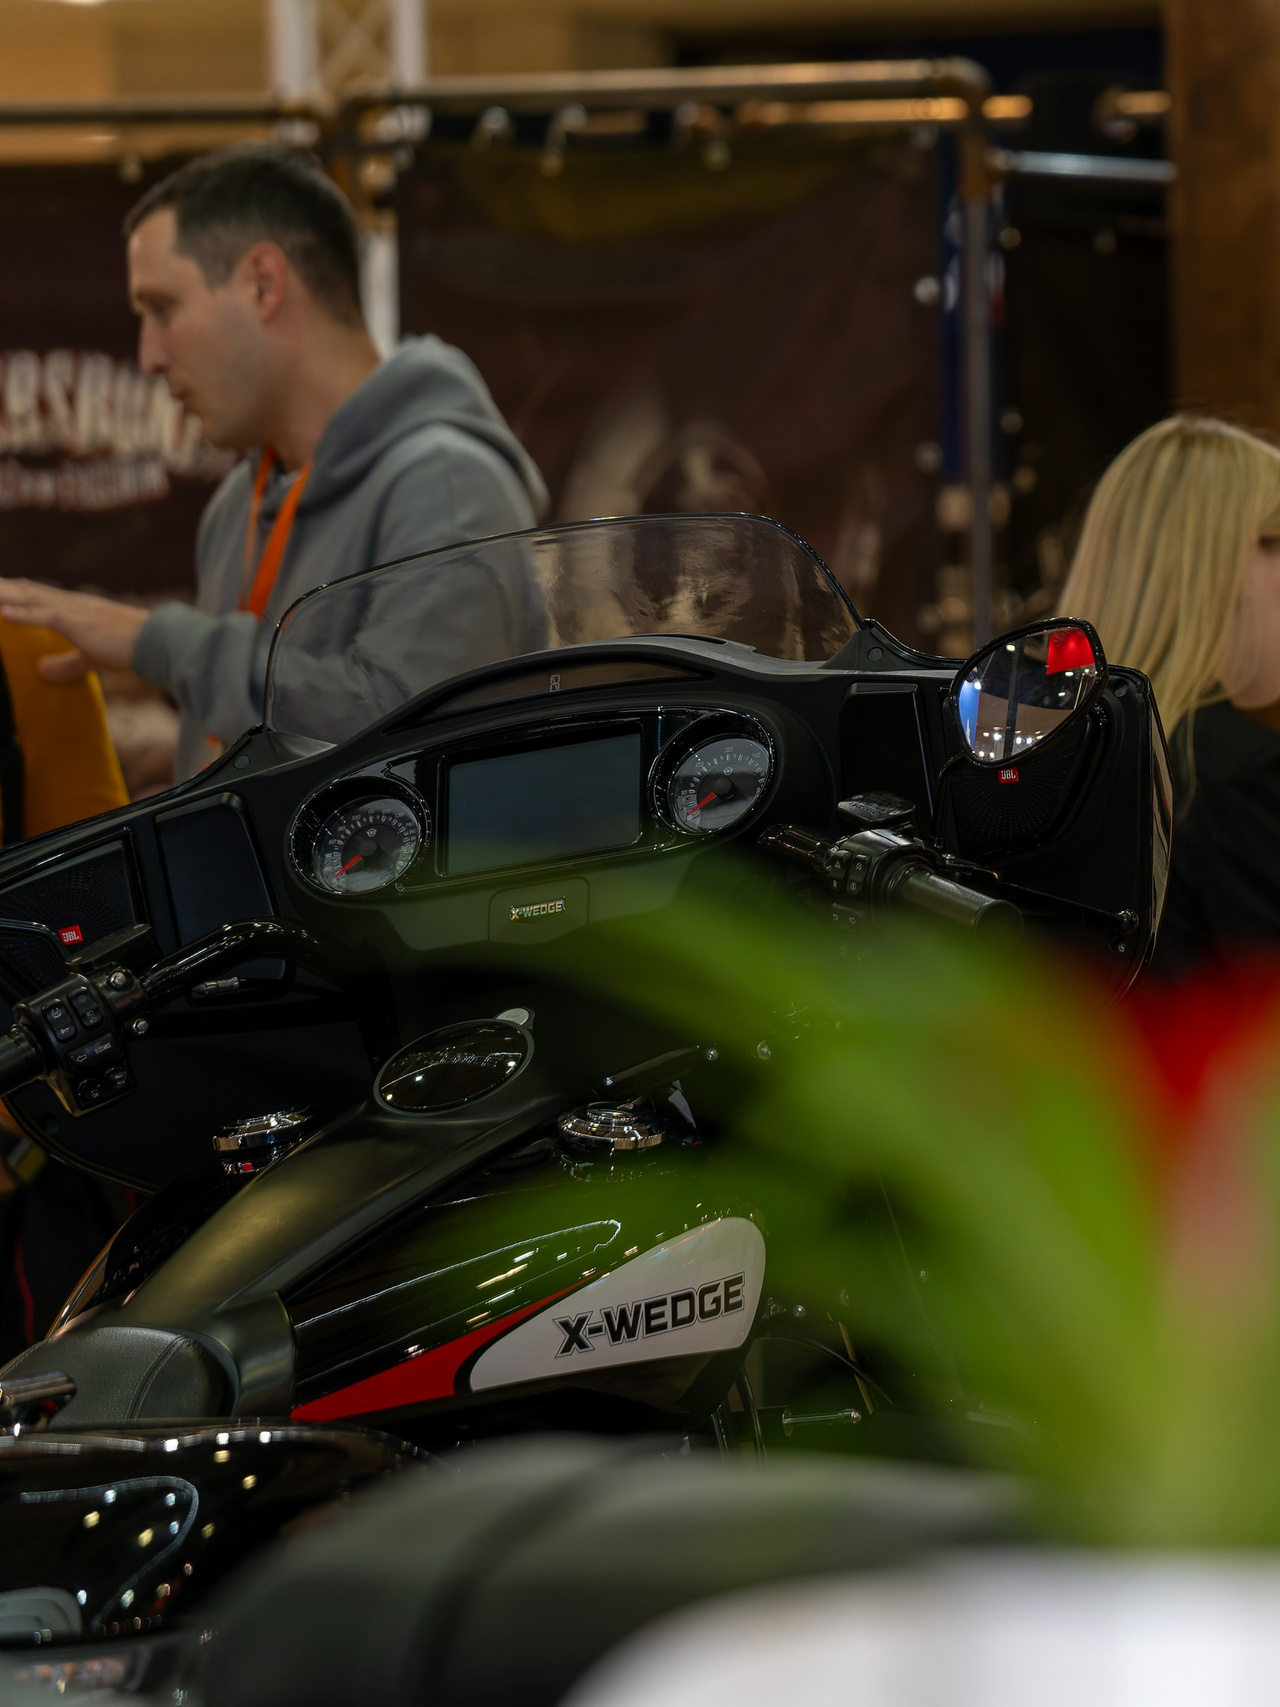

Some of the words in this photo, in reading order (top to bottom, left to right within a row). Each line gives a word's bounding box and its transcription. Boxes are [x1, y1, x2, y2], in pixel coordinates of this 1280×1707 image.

[1001, 769, 1016, 780] JBL
[510, 900, 564, 921] X-WEDGE
[62, 930, 80, 942] JBL
[553, 1271, 745, 1358] X-WEDGE
